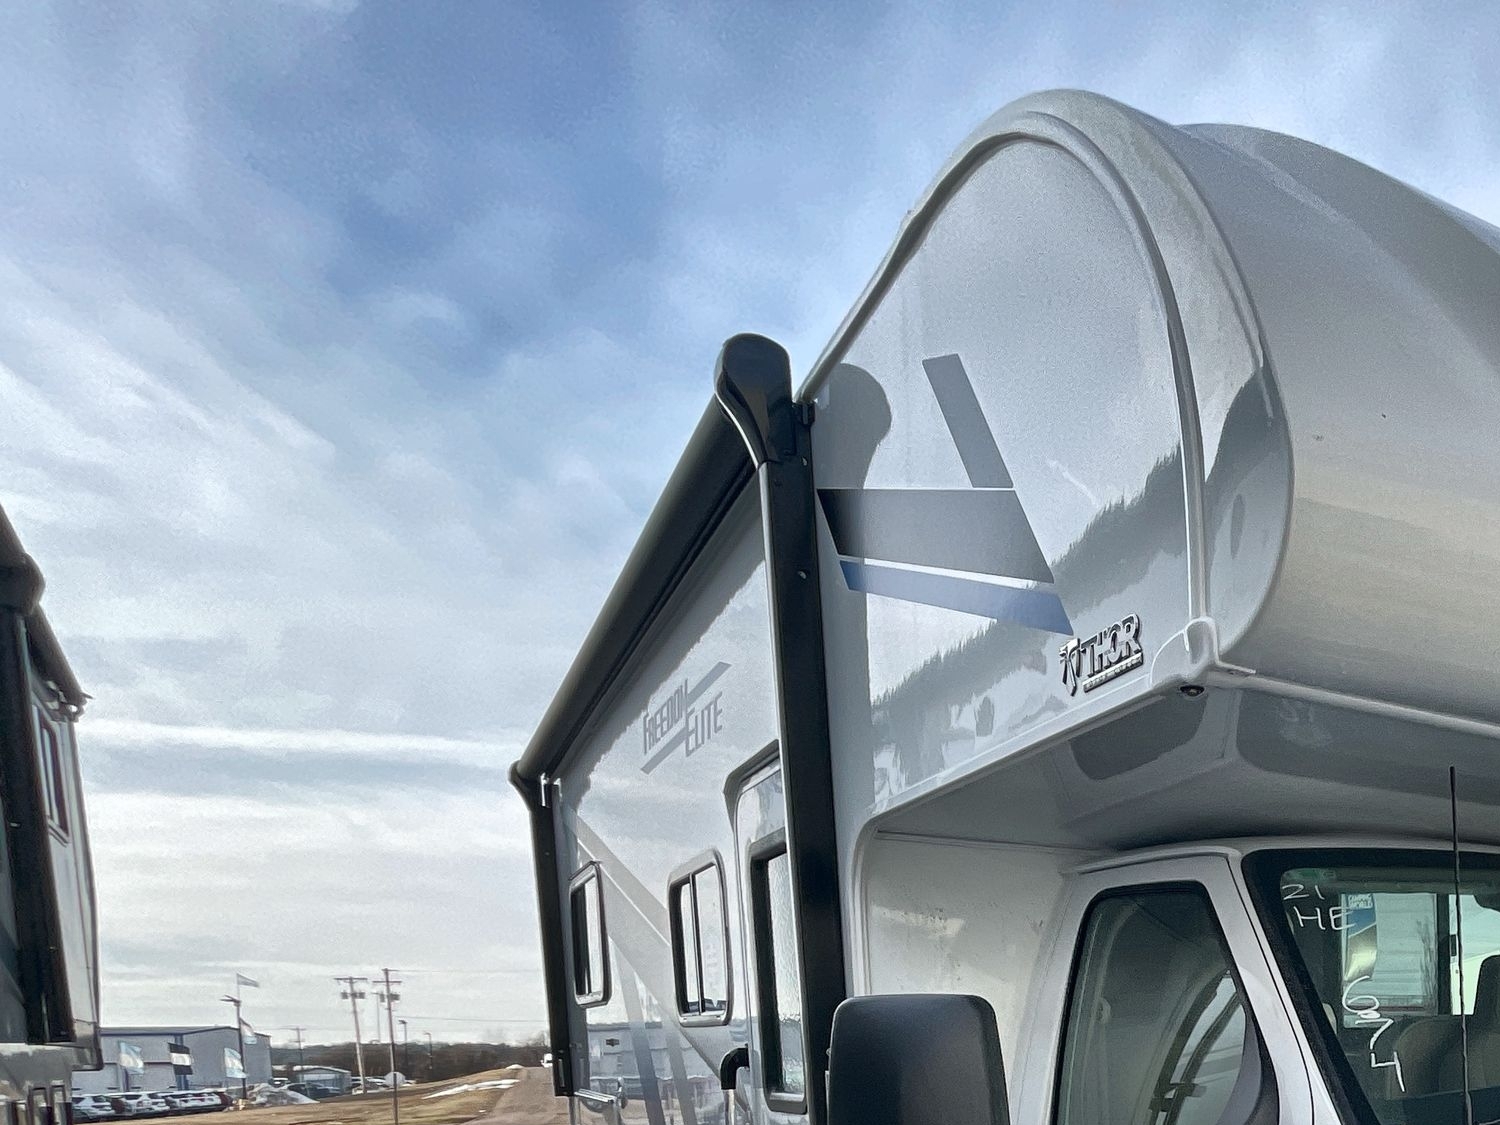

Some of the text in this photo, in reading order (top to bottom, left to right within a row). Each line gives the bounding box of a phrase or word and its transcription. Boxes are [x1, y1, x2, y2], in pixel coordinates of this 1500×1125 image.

[1080, 613, 1142, 678] THOR
[643, 678, 688, 756] FREEDOM
[685, 690, 723, 757] ELITE
